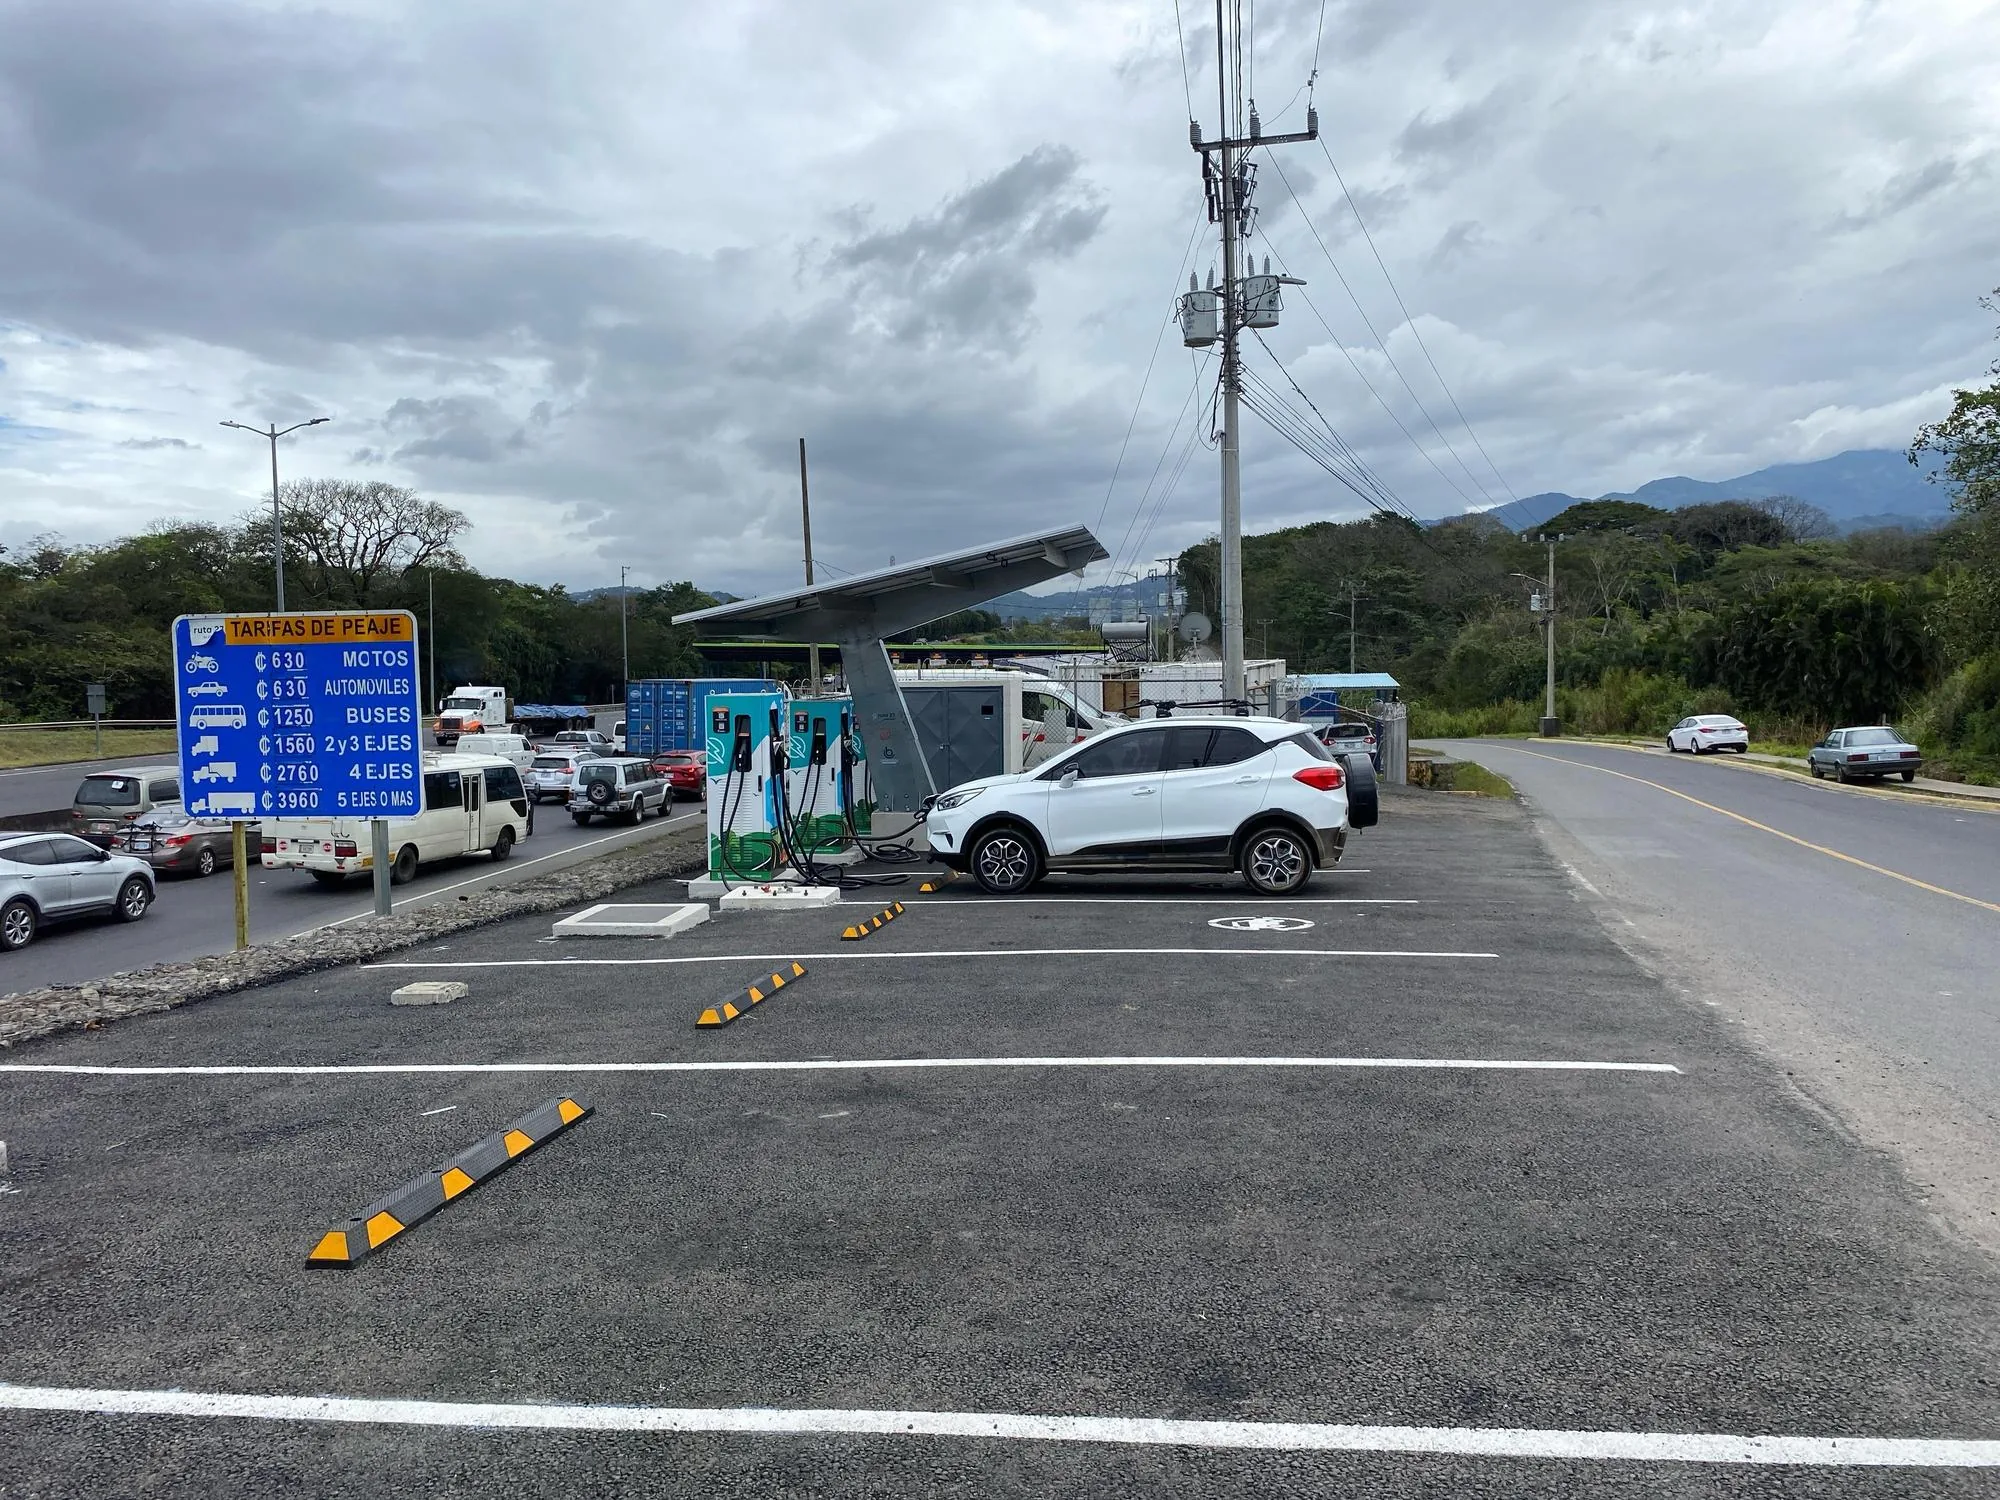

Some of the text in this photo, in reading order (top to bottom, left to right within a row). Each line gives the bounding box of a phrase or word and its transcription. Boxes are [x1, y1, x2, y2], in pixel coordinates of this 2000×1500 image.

[193, 626, 212, 634] ruta
[231, 617, 401, 637] TARIFAS DE PEAJE
[272, 652, 304, 668] 630
[343, 650, 408, 667] MOTOS
[273, 680, 306, 697] 630
[325, 678, 409, 695] AUTOMOVILES
[274, 708, 313, 725] 1250
[347, 707, 411, 724] BUSES
[275, 737, 315, 754] 1560
[365, 735, 412, 751] EJES
[277, 765, 319, 781] 2760
[349, 764, 361, 780] 4
[366, 763, 413, 780] EJES
[278, 792, 319, 809] 3960
[338, 792, 347, 807] 5
[352, 791, 377, 807] EJES
[380, 791, 388, 807] O
[391, 790, 414, 807] MAS
